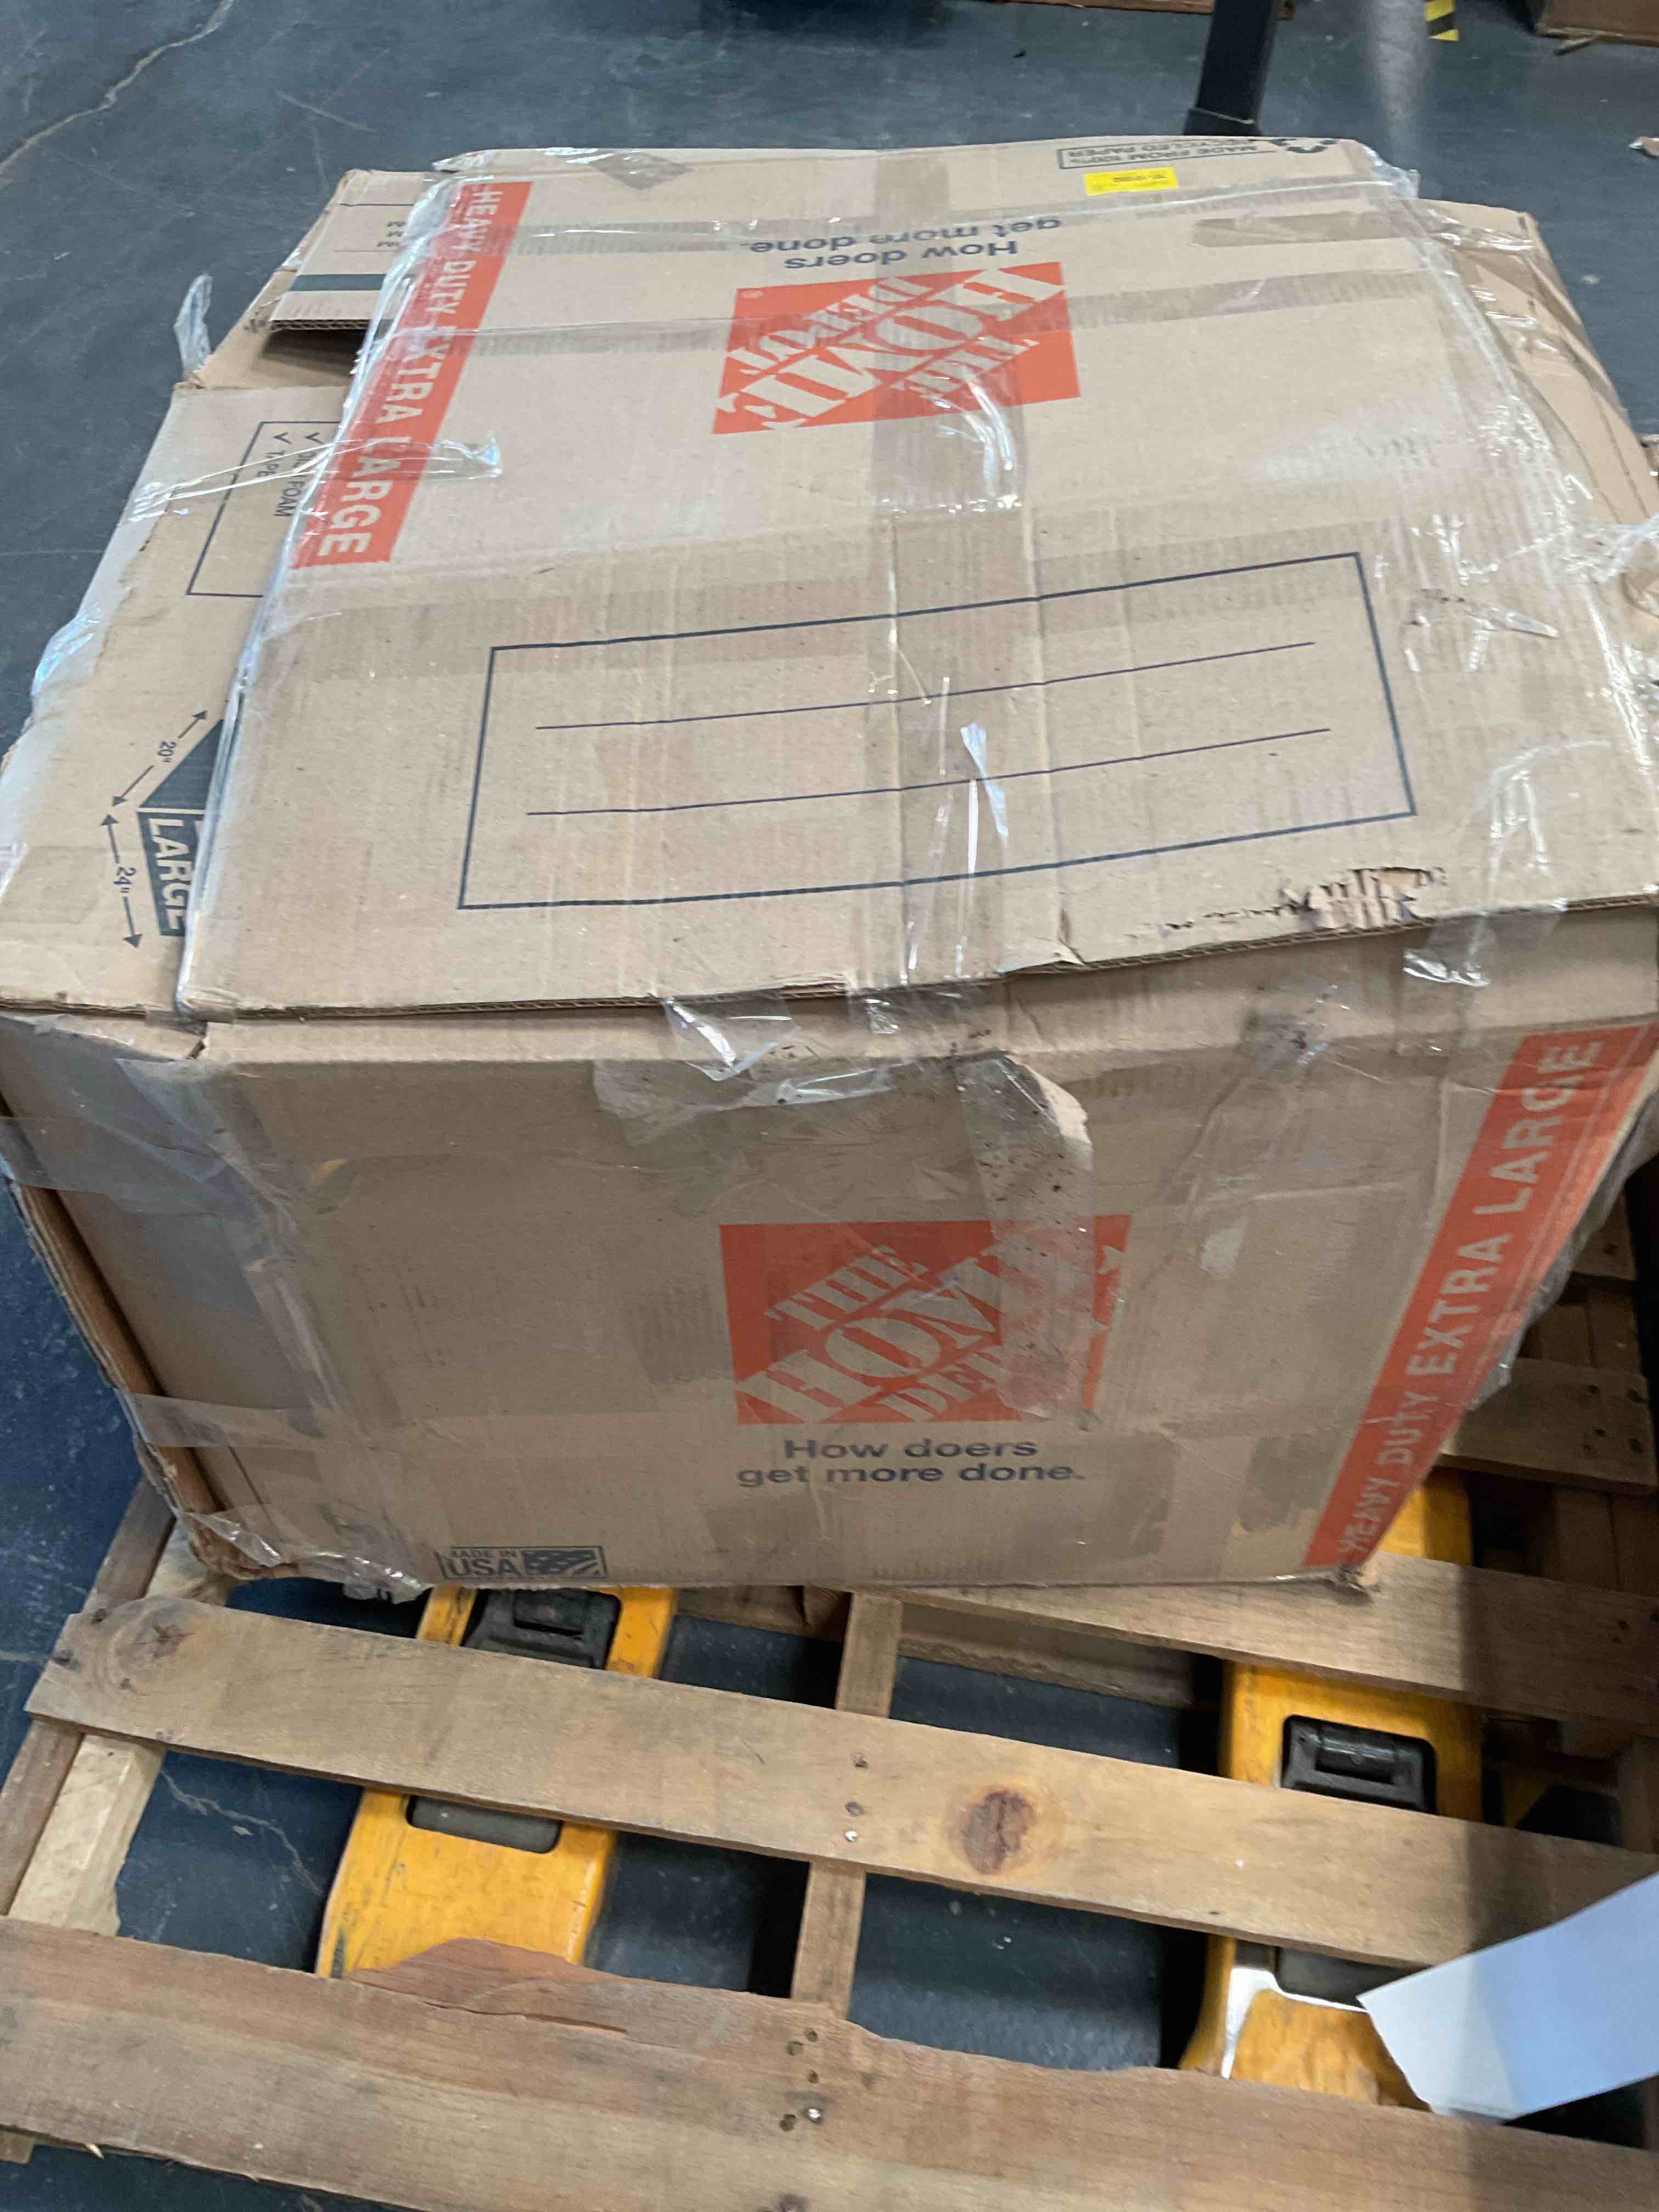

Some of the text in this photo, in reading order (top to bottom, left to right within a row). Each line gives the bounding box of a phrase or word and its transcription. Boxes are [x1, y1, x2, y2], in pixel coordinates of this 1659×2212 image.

[1068, 147, 1136, 157] PAPER
[1128, 150, 1190, 161] FROM
[453, 190, 504, 252] HEAVY
[868, 223, 979, 245] more
[992, 218, 1063, 238] get
[782, 240, 1018, 270] How doers
[425, 259, 477, 314] DUTY
[716, 269, 1065, 430] HOME
[319, 436, 413, 556] LARGE
[1475, 1037, 1602, 1216] LARGE
[1406, 1232, 1512, 1376] EXTRA
[1376, 1390, 1440, 1466] DUTY
[783, 1436, 1040, 1460] How doers
[735, 1462, 1086, 1488] get more done.
[445, 1558, 521, 1577] USA
